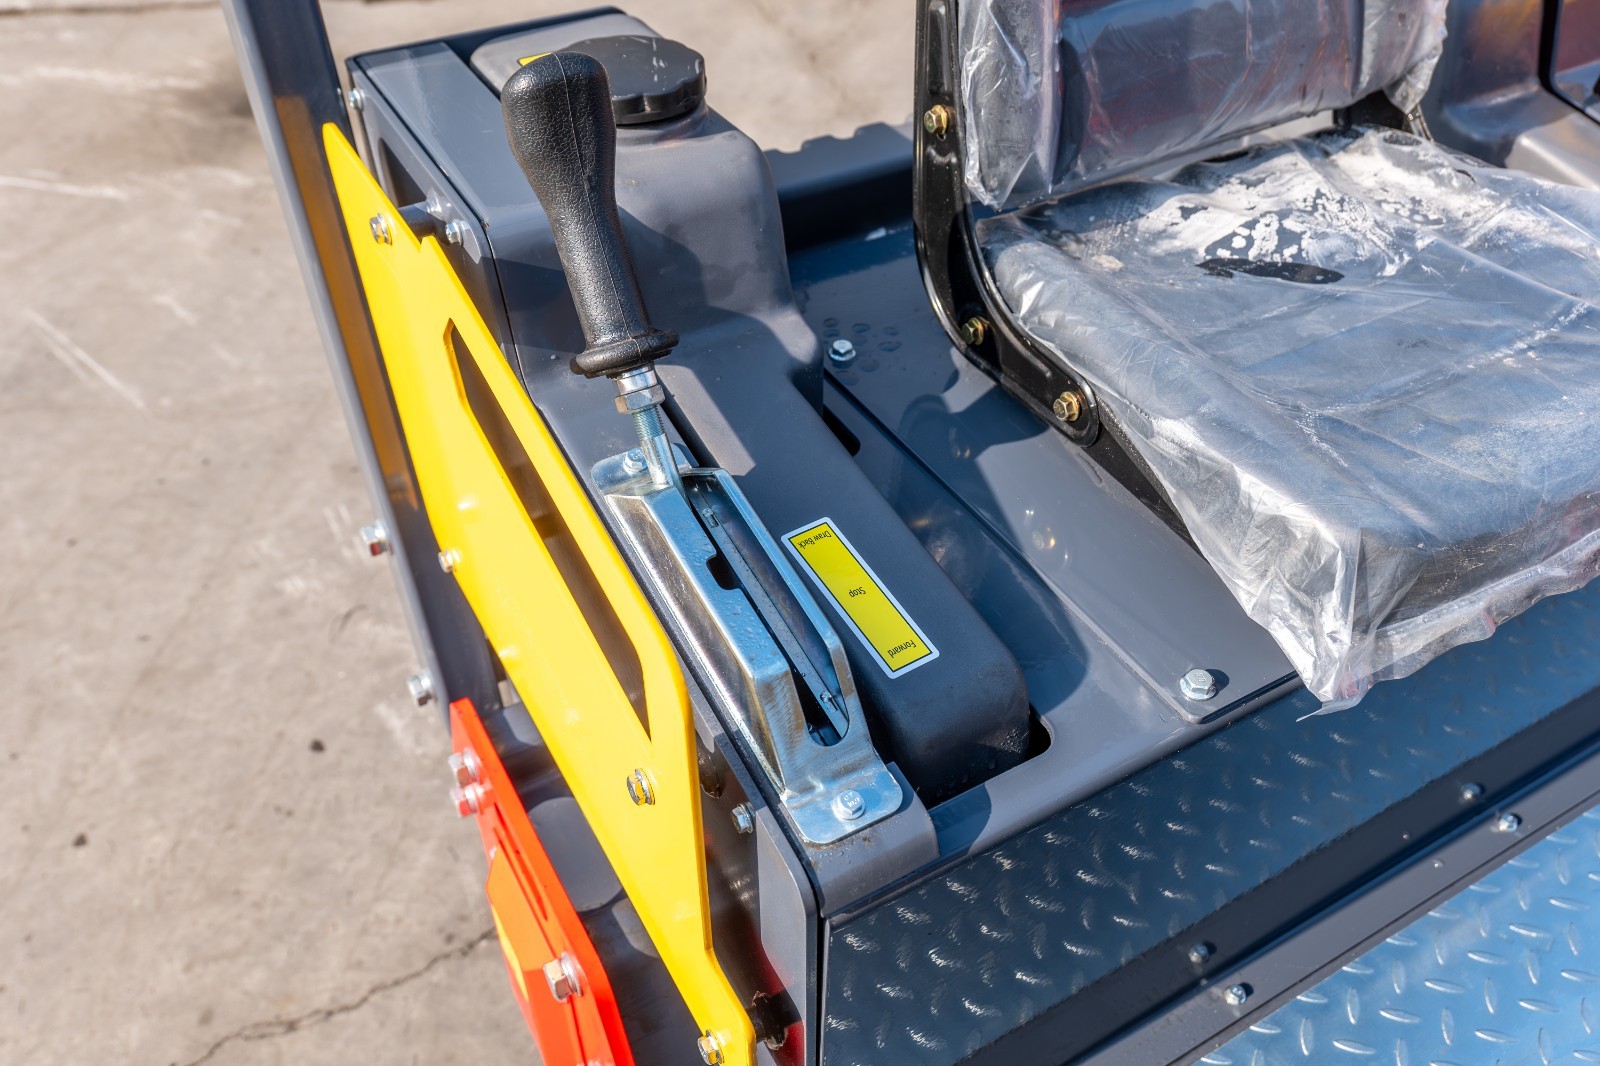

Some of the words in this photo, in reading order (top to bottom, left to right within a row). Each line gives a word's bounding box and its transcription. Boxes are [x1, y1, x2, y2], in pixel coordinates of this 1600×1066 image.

[813, 530, 832, 542] Draw
[797, 537, 816, 549] Back
[848, 586, 866, 598] Stop
[887, 639, 917, 659] Forward
